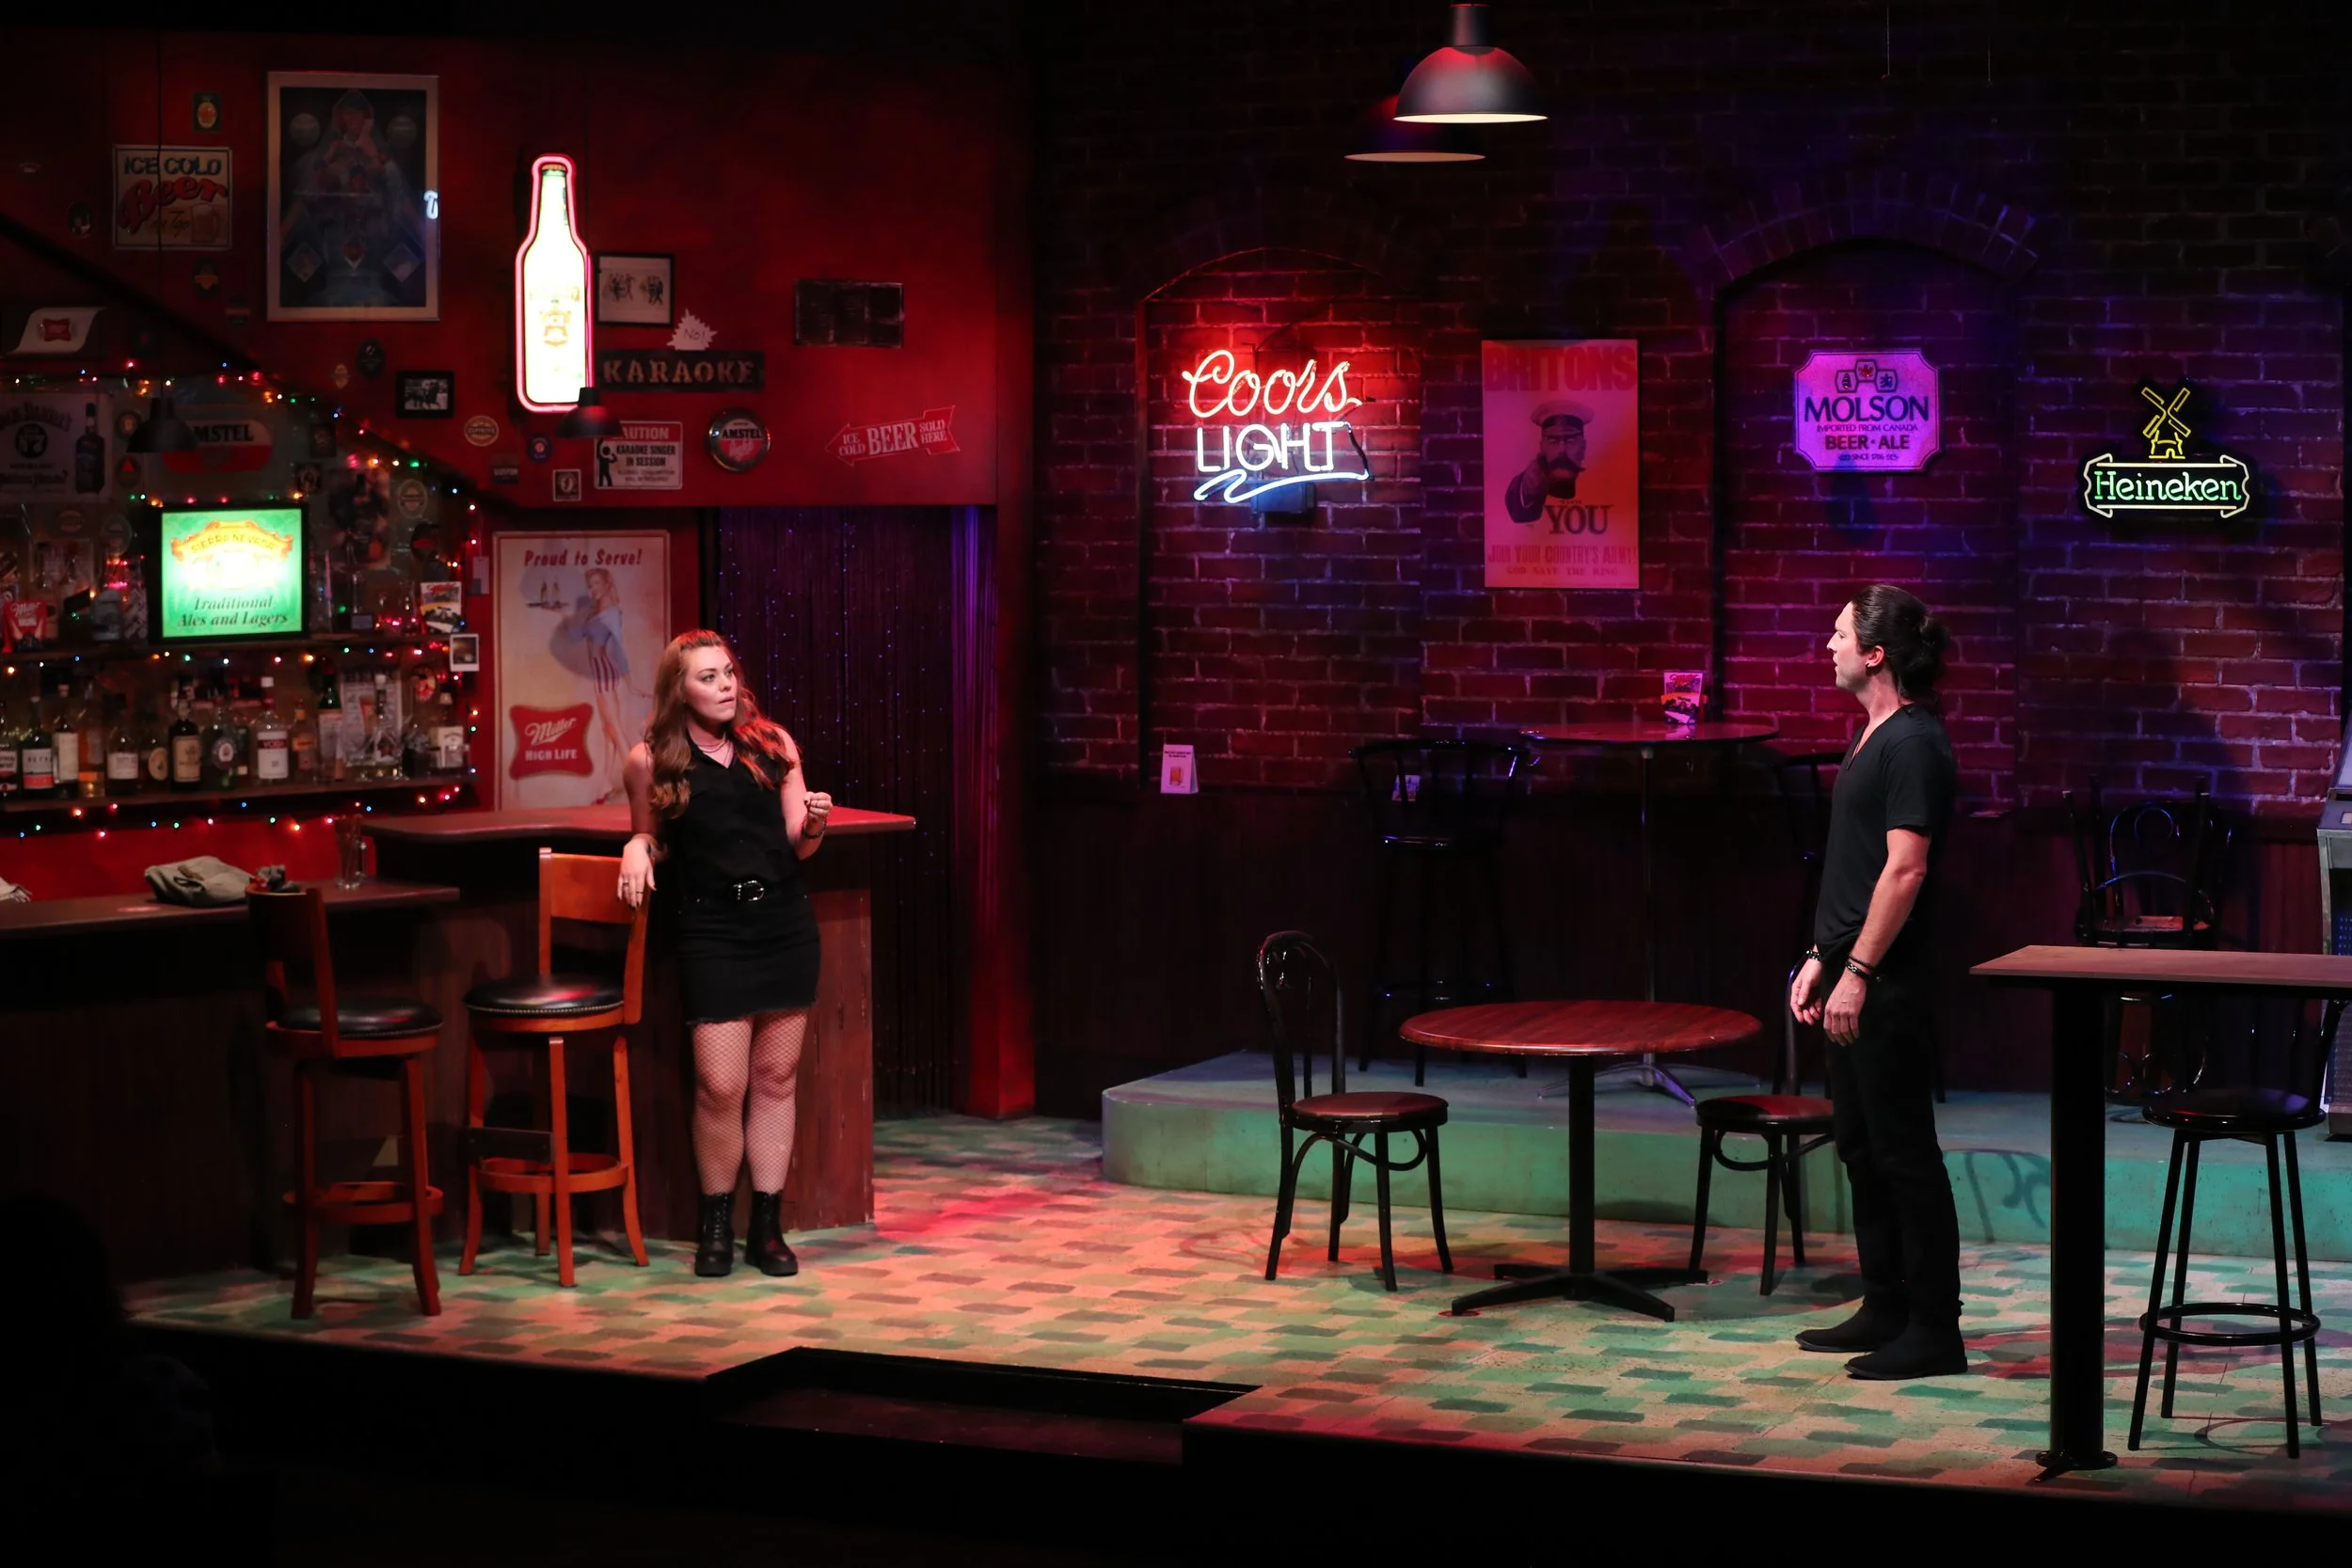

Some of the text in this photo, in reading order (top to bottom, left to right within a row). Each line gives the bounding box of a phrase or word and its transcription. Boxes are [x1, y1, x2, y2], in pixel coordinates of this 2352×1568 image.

[124, 156, 222, 176] ICE COLD
[603, 358, 755, 385] KARAOKE
[1484, 345, 1637, 391] BRITONS
[1182, 349, 1362, 418] Coors
[1804, 395, 1930, 422] MOLSON
[192, 424, 254, 442] MSTEL
[613, 425, 670, 440] AUTION
[722, 428, 763, 439] AMSTEL
[918, 420, 946, 433] SOLD
[1817, 423, 1919, 433] IMPORTED FROM CANADA
[842, 432, 860, 446] ICE
[866, 421, 919, 455] BEER
[920, 430, 947, 444] HERE
[1878, 435, 1911, 451] ALE
[838, 443, 866, 457] COLD
[1197, 422, 1345, 472] LIGHT
[2093, 470, 2242, 501] Heineken
[1544, 504, 1614, 535] YOU
[524, 548, 643, 566] Proud to Serve!
[1487, 544, 1511, 563] JOIN
[1515, 544, 1541, 563] YOUR
[1544, 545, 1599, 564] COUNTRY'S
[1506, 566, 1618, 577] GOD SAVE THE KING
[194, 596, 273, 611] Traditional
[178, 611, 288, 627] Ales and Lagers
[525, 718, 577, 746] Miller
[525, 749, 578, 761] HIGH LIFE
